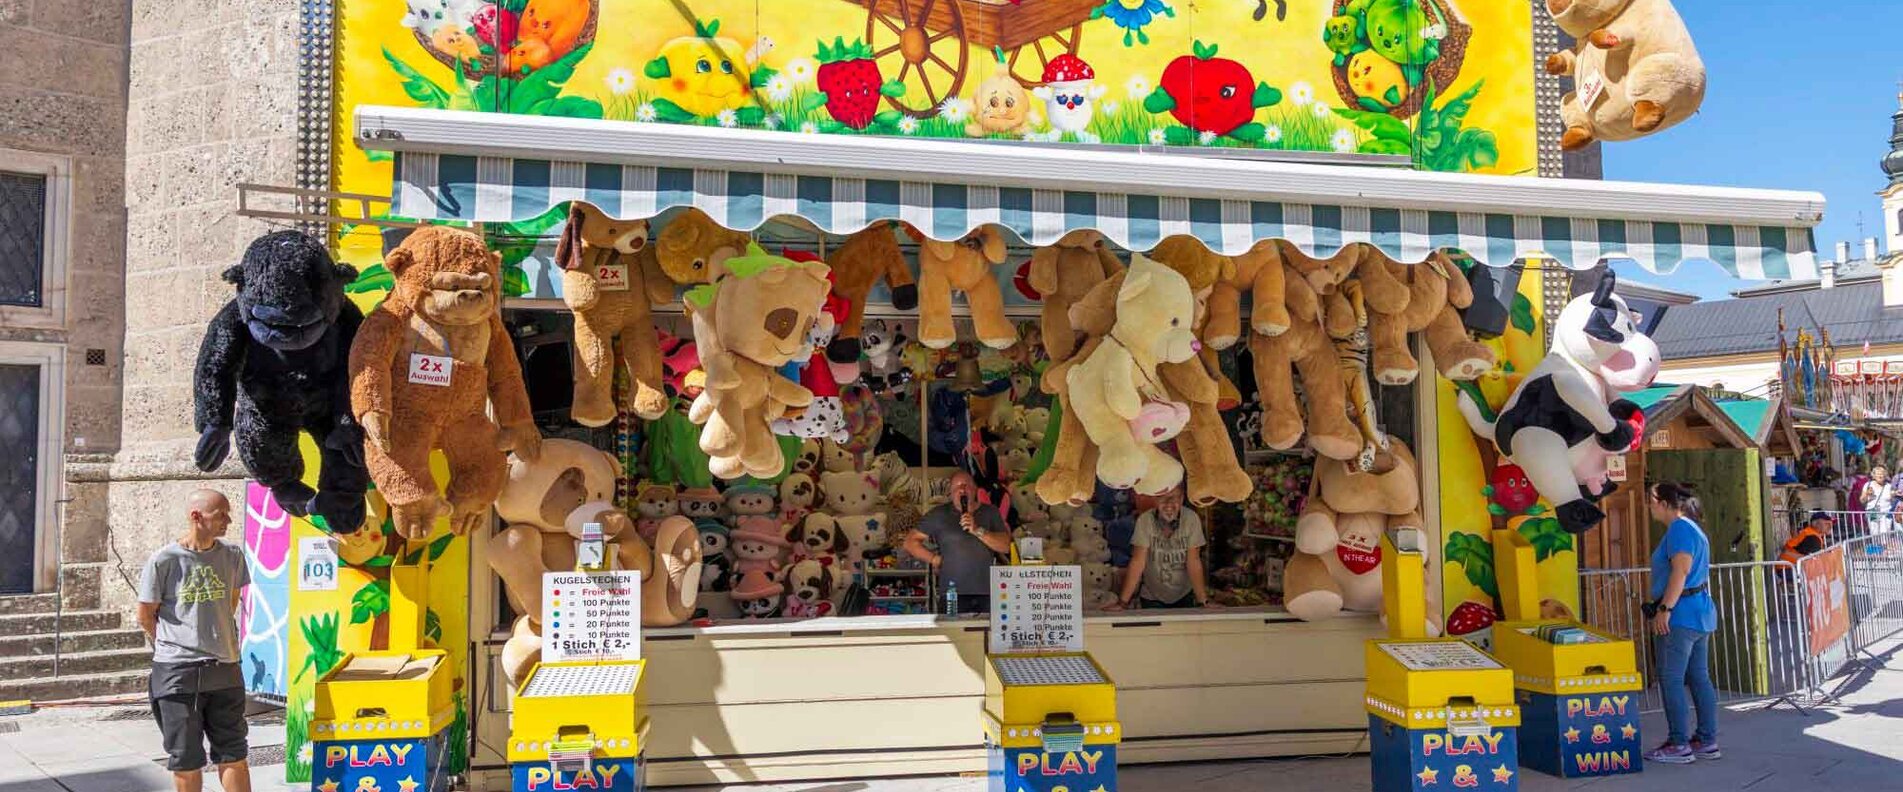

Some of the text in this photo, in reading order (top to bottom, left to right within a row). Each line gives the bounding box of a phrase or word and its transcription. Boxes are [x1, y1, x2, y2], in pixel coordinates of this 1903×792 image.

[599, 267, 609, 279] 2
[420, 357, 430, 371] 2
[411, 372, 449, 383] Auswahl
[304, 563, 333, 577] 103
[553, 576, 631, 584] KUGELSTECHEN
[608, 587, 630, 596] Wahl
[600, 609, 630, 617] Punkte
[1001, 633, 1006, 641] 1
[1011, 632, 1042, 640] Stich
[552, 641, 557, 649] 1
[563, 640, 596, 649] Stich
[1567, 695, 1629, 718] PLAY
[1591, 724, 1611, 744] &
[1423, 732, 1504, 756] PLAY
[326, 743, 413, 768] PLAY
[1575, 750, 1630, 773] WIN
[1018, 750, 1103, 776] PLAY
[528, 764, 620, 791] PLAY
[1452, 764, 1478, 787] &
